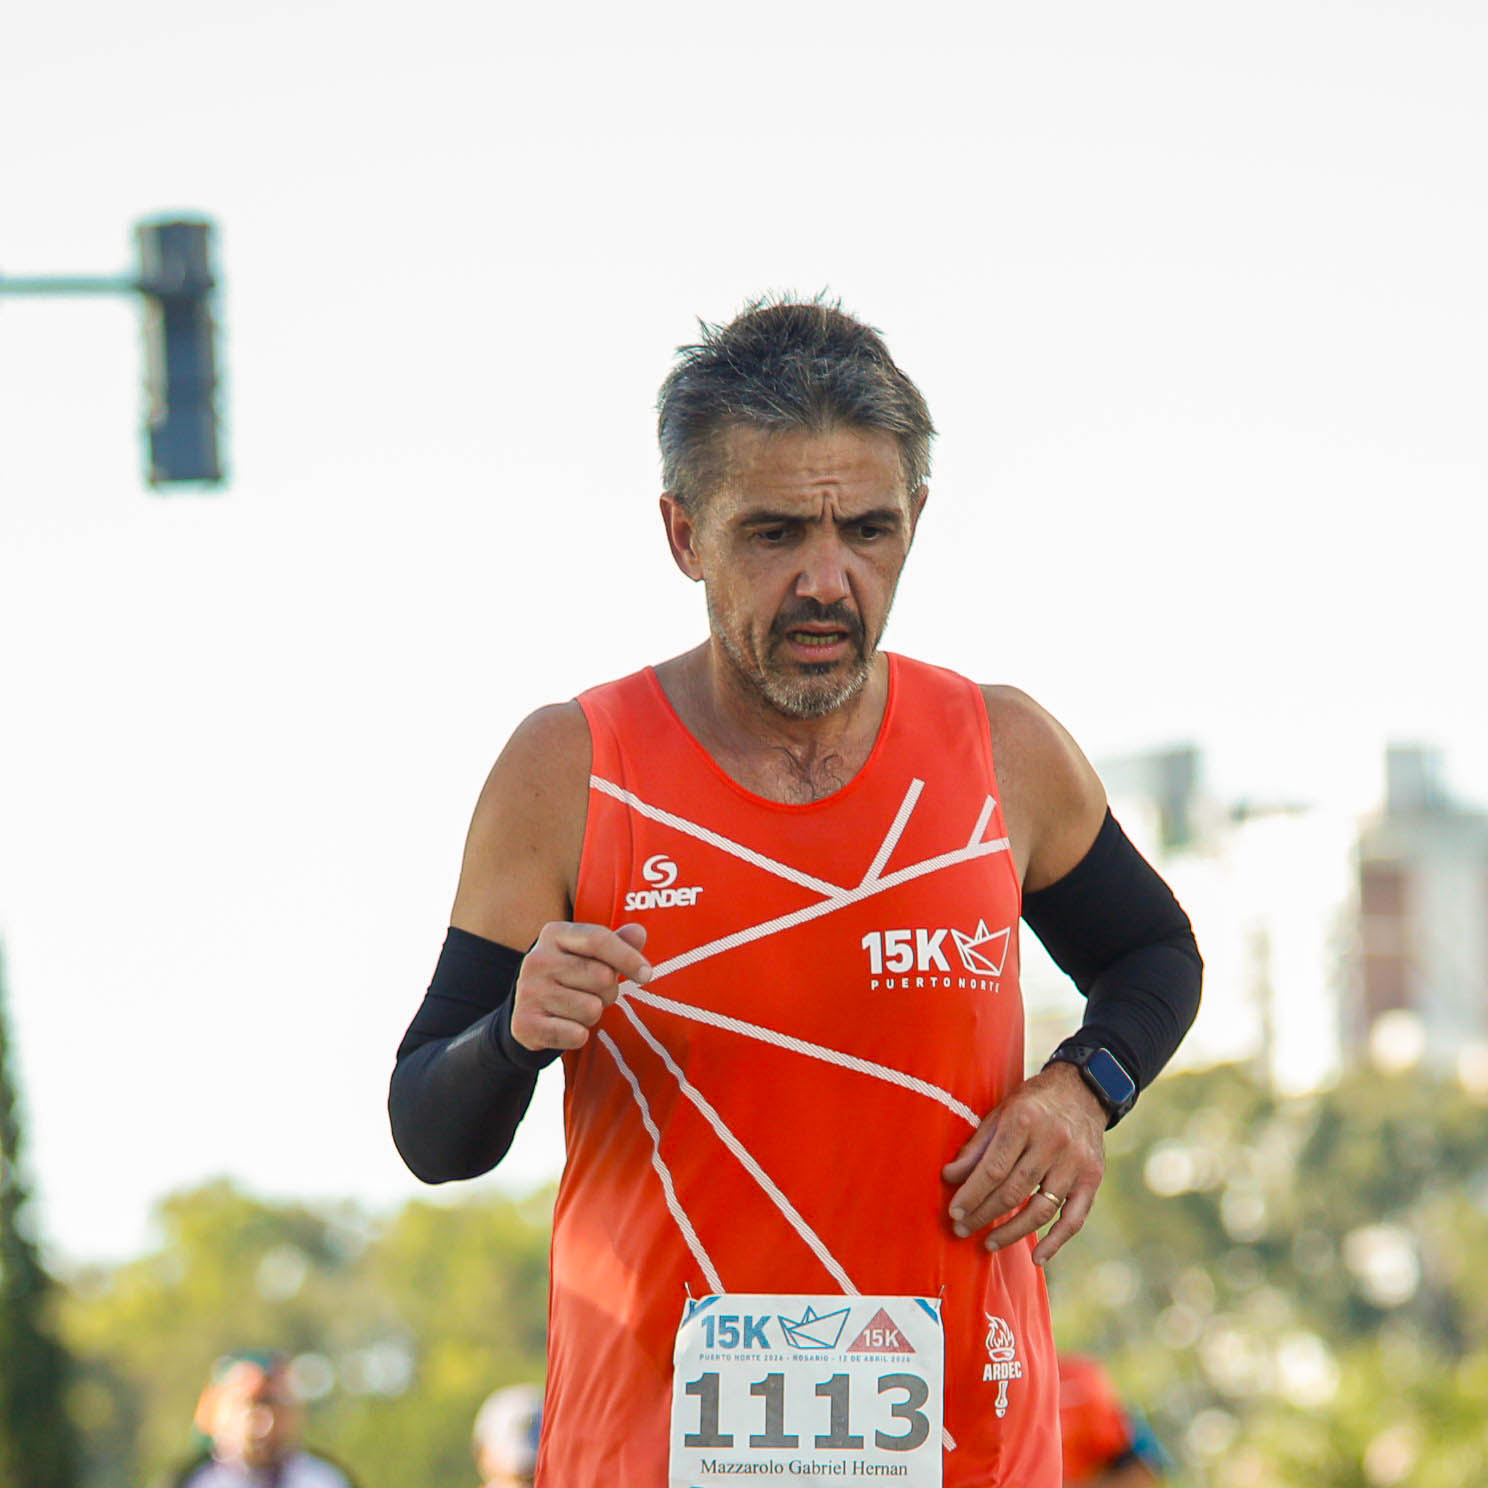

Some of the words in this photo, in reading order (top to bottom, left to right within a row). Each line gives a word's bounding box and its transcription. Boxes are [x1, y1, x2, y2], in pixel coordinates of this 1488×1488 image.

[861, 928, 952, 975] 15K
[871, 976, 951, 990] PUERTO
[701, 1314, 772, 1350] 15K
[863, 1329, 900, 1348] 15K
[983, 1361, 1022, 1382] ARDEC
[684, 1371, 931, 1452] 1113
[700, 1459, 784, 1475] Mazzarolo
[788, 1460, 847, 1476] Gabriel
[852, 1461, 908, 1476] Hernan
